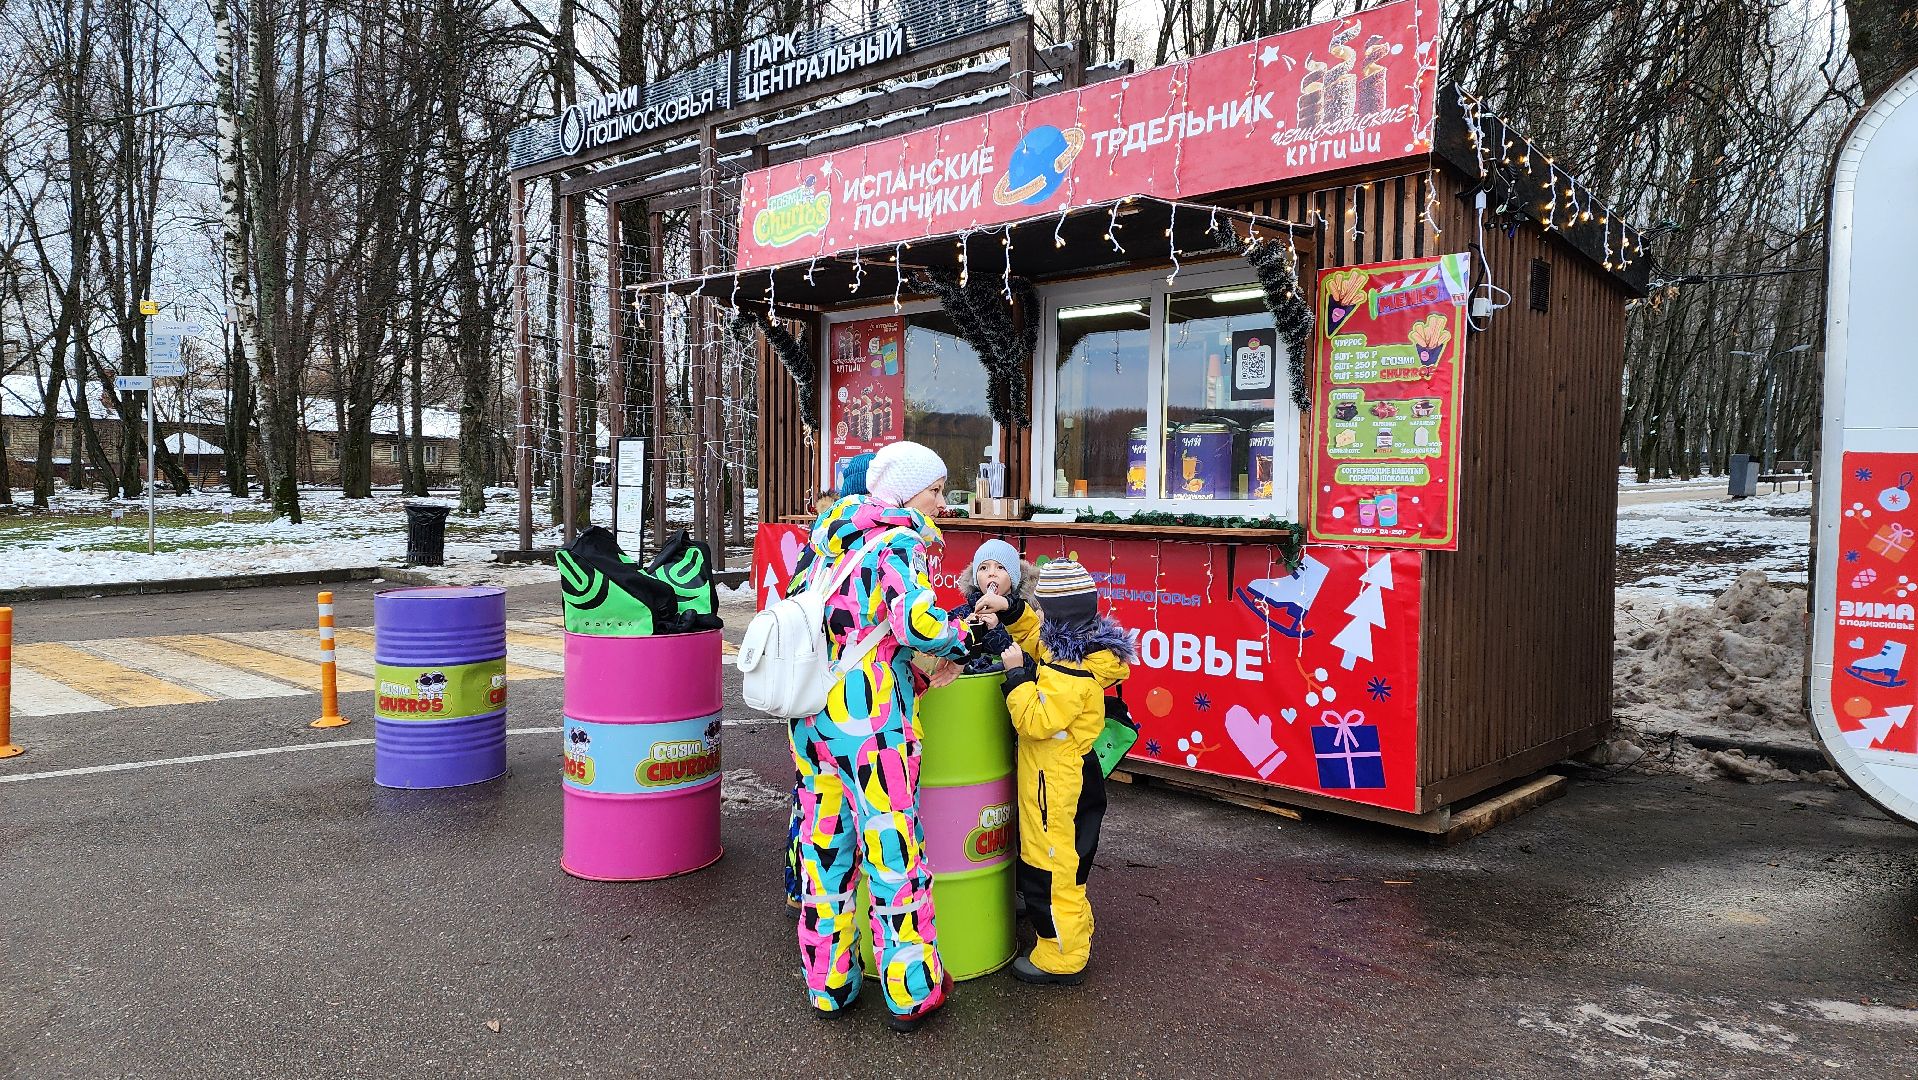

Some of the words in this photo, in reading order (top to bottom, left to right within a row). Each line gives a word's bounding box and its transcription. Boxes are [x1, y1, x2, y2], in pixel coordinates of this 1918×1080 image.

[745, 31, 799, 71] ПАРК
[745, 22, 903, 101] ЦЕНТРАЛЬНЫЙ
[585, 87, 714, 149] ПОДМОСКОВЬЯ
[587, 84, 638, 122] ПАРКИ
[1091, 91, 1274, 158] ТРДЕЛЬНИК
[1286, 131, 1381, 167] КРУТИШИ
[842, 145, 995, 204] ИСПАНСКИЕ
[853, 178, 981, 231] ПОНЧИКИ
[1839, 600, 1915, 621] ЗИМА
[1847, 619, 1915, 631] ПОДМОСКОВЬЕ
[379, 695, 444, 713] CHURROS
